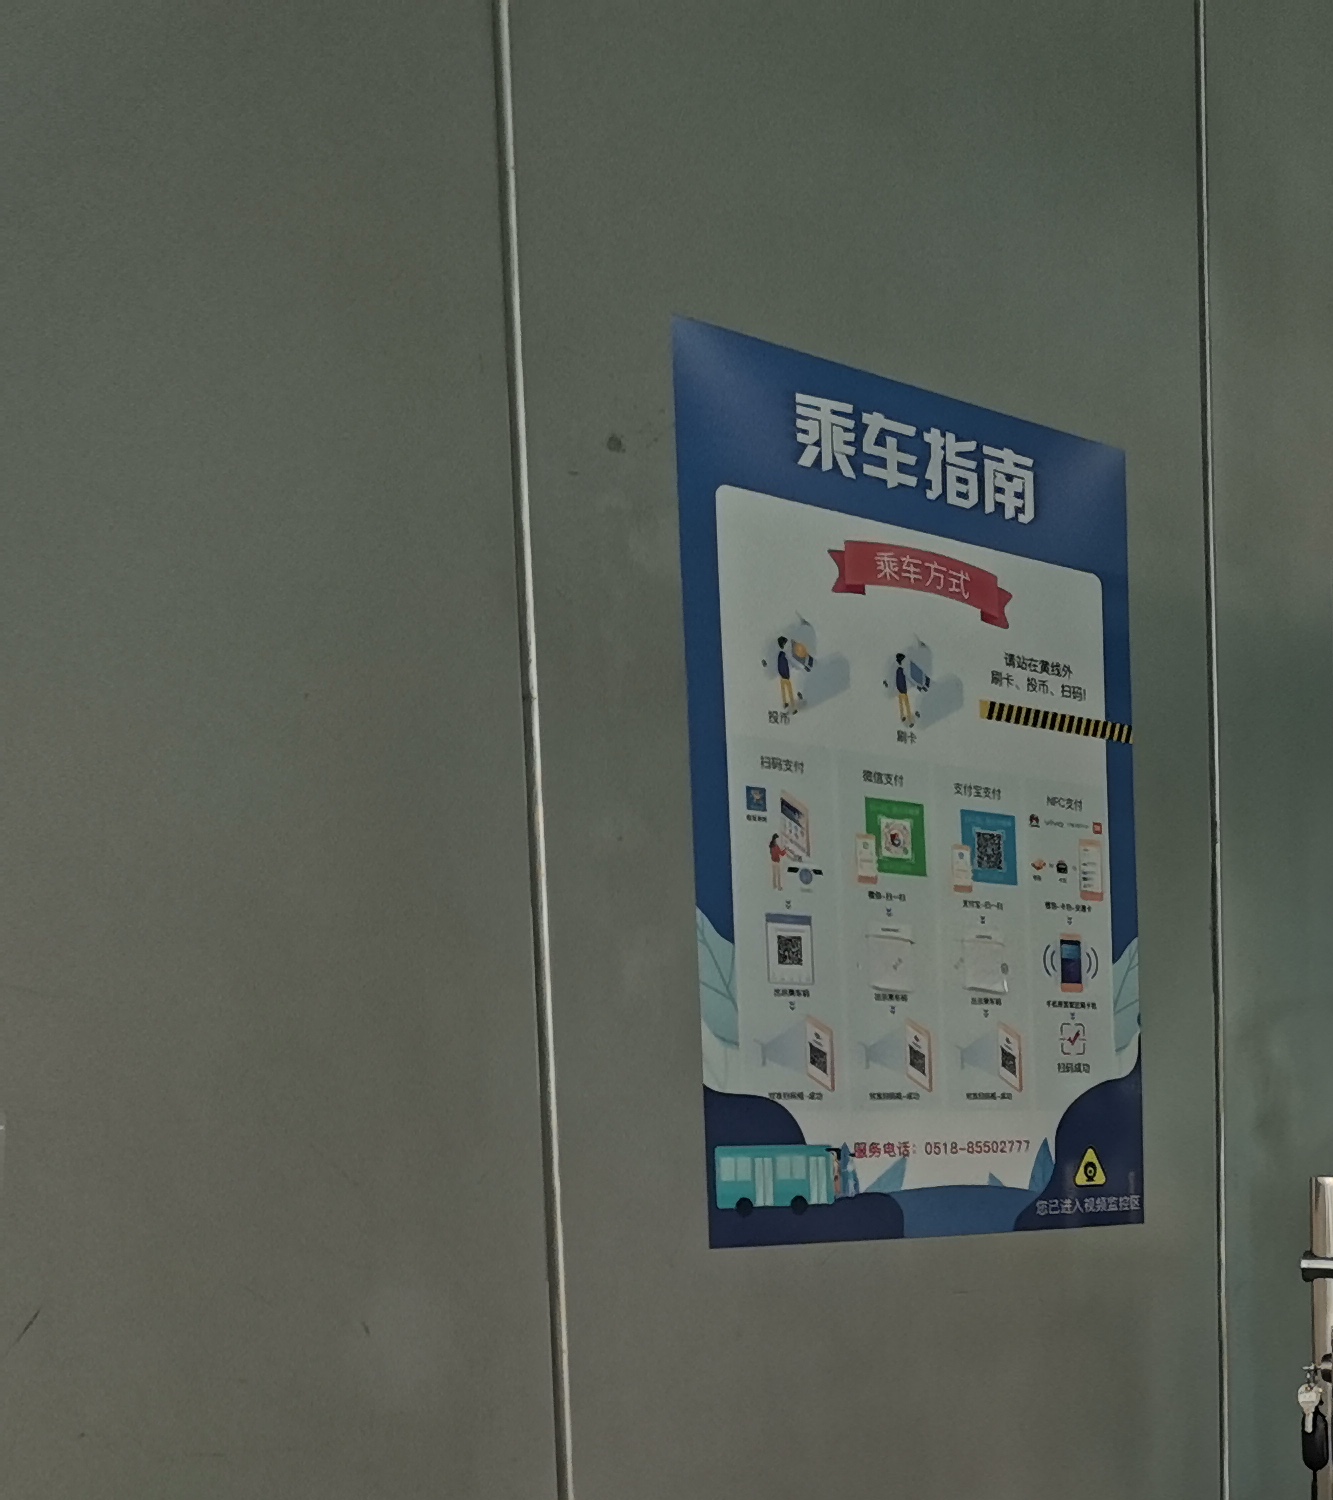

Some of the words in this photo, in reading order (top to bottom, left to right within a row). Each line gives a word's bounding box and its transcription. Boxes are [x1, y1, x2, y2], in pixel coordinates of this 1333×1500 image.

[795, 392, 1036, 524] 乘车指南
[874, 551, 971, 600] 乘车方式
[1003, 651, 1073, 680] 请站在黄线外
[768, 710, 790, 725] 投币
[759, 755, 804, 775] 扫码支付
[862, 769, 904, 788] 微信支付
[953, 782, 1002, 801] 支付宝支付
[1046, 795, 1083, 812] NFC支付
[924, 1140, 1030, 1156] 0518-85502777
[1036, 1195, 1140, 1216] 您已进入视频监控区
